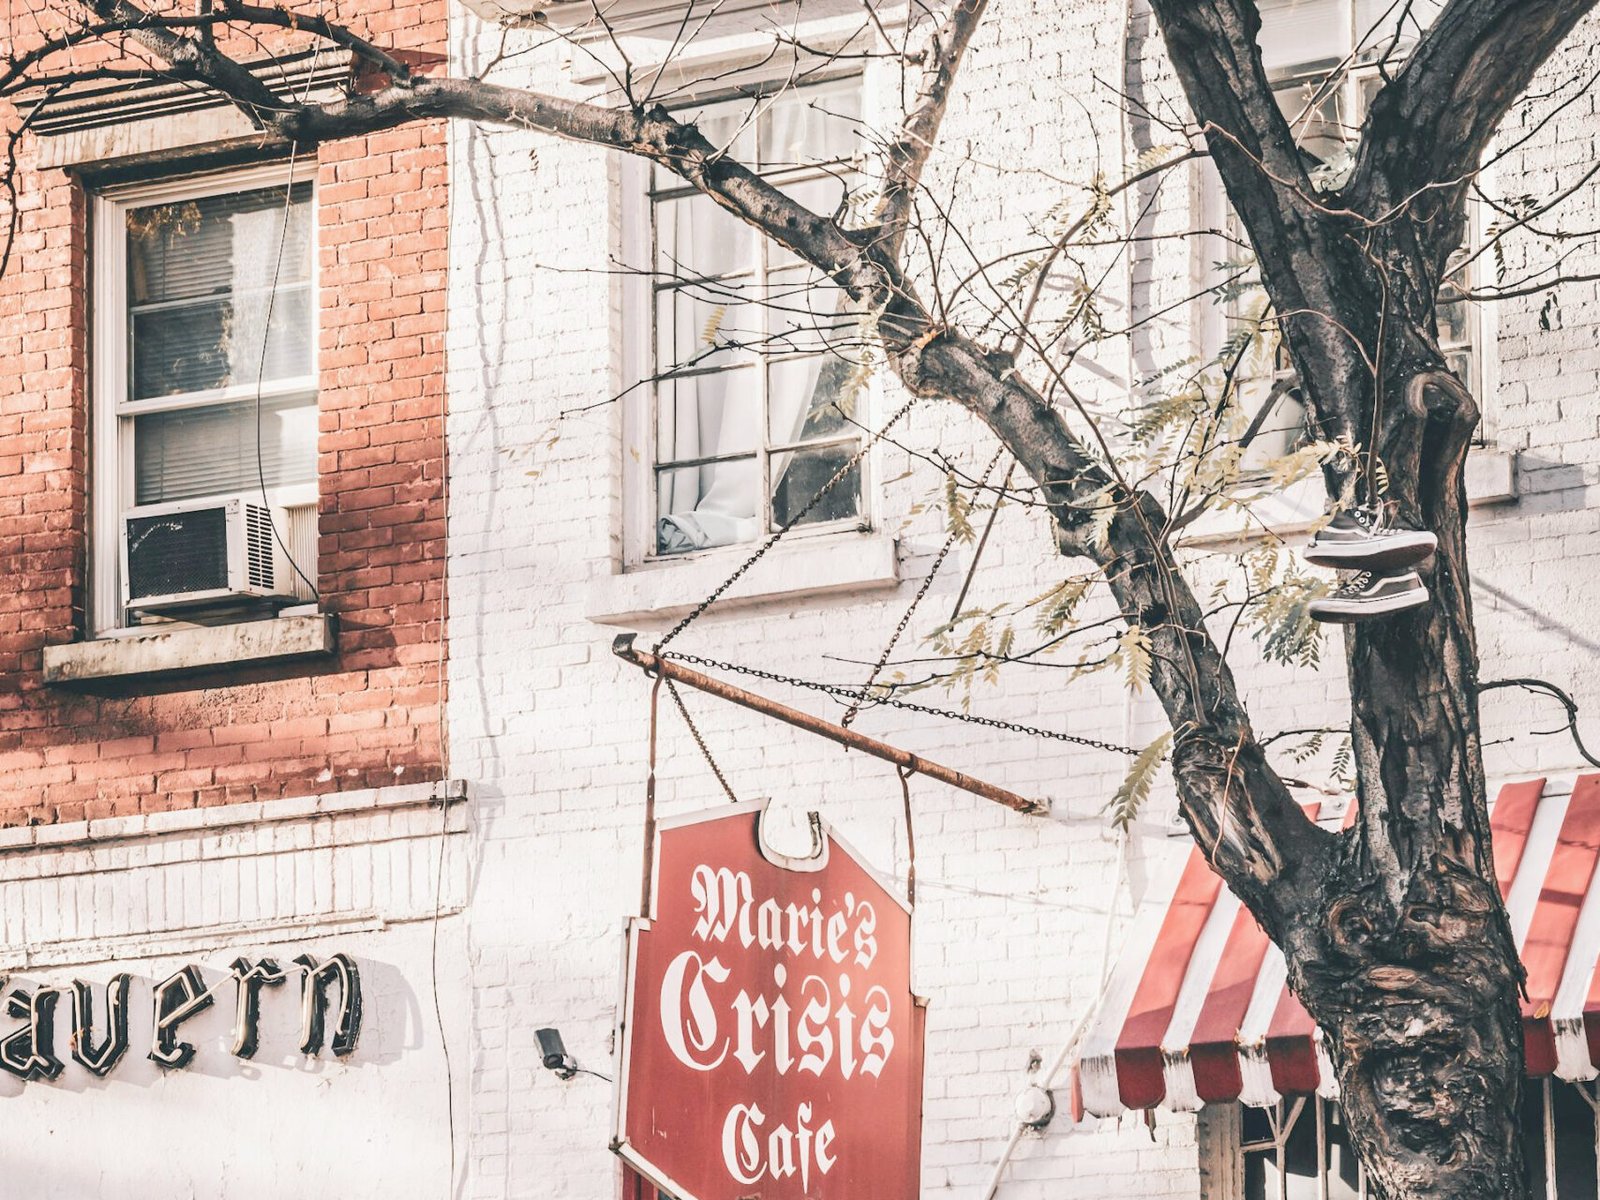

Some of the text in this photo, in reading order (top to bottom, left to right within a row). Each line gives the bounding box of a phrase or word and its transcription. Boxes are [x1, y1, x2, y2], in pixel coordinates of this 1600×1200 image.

[690, 864, 878, 970] Marie's
[0, 953, 363, 1082] avern
[660, 950, 895, 1080] Crisis
[721, 1100, 838, 1194] Cafe
